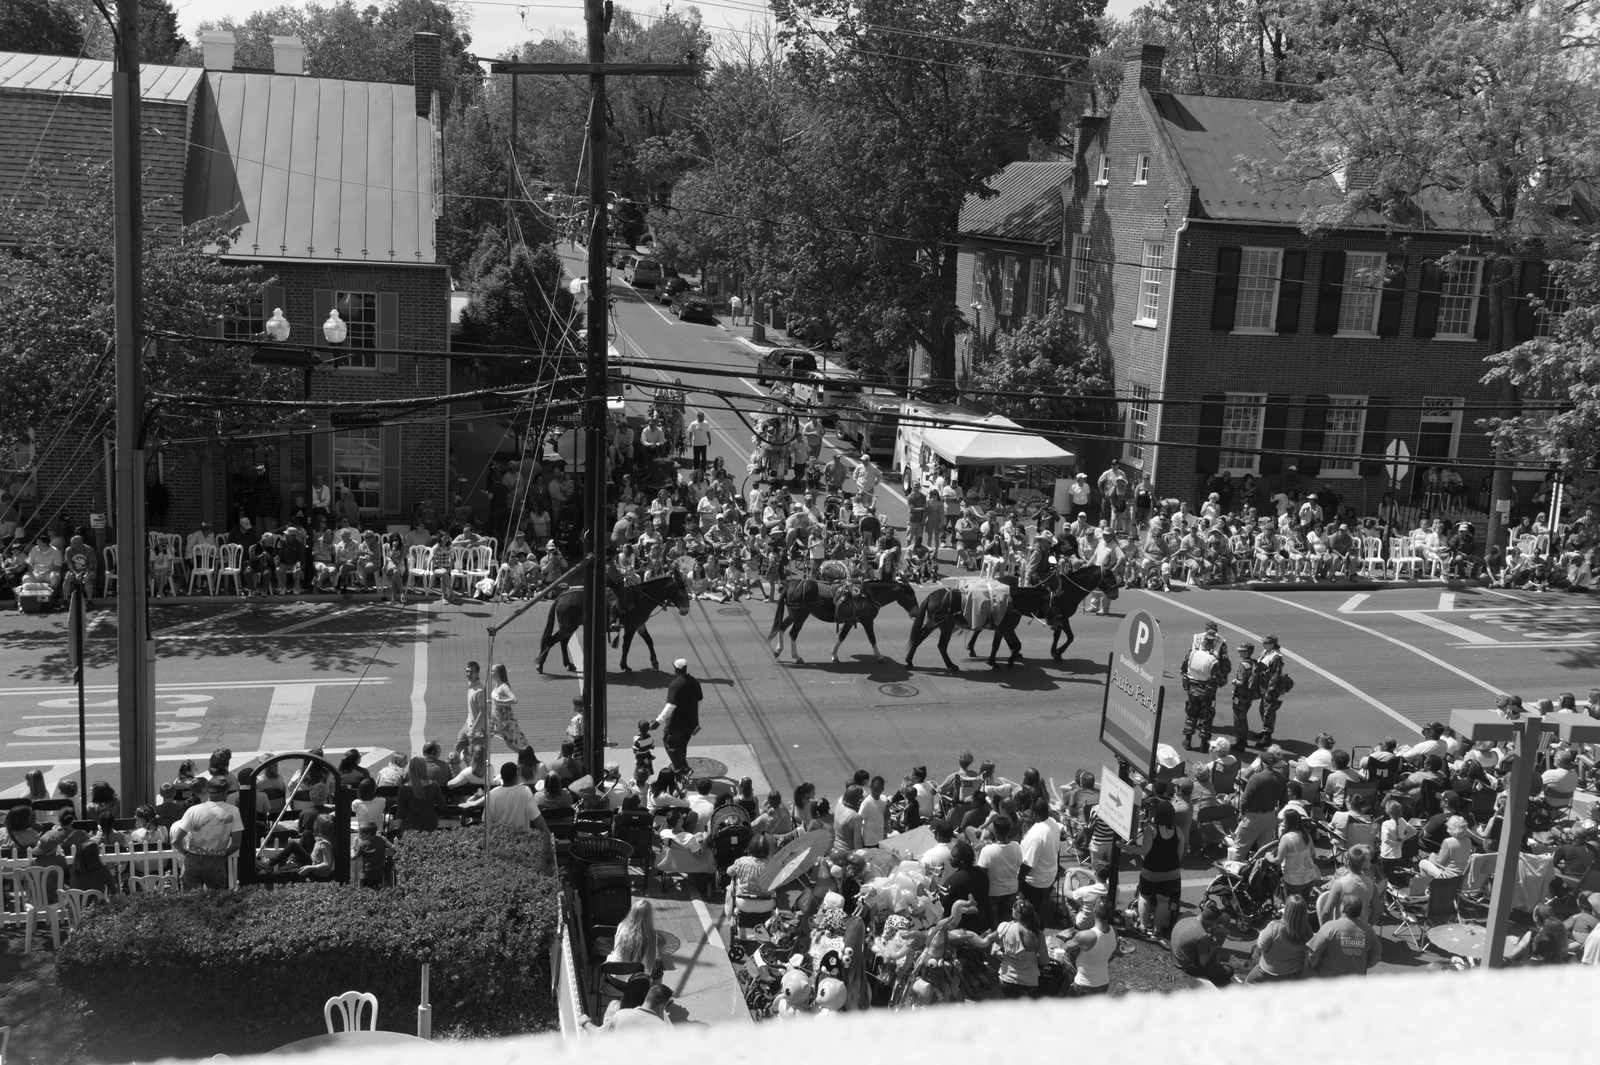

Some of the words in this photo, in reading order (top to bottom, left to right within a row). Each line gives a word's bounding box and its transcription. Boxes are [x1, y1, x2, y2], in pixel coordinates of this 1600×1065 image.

[1134, 620, 1150, 655] P
[1120, 653, 1140, 674] Braddock
[1140, 667, 1154, 684] Street
[1111, 668, 1134, 697] Auto
[1135, 684, 1157, 715] Park
[6, 694, 214, 751] STOP
